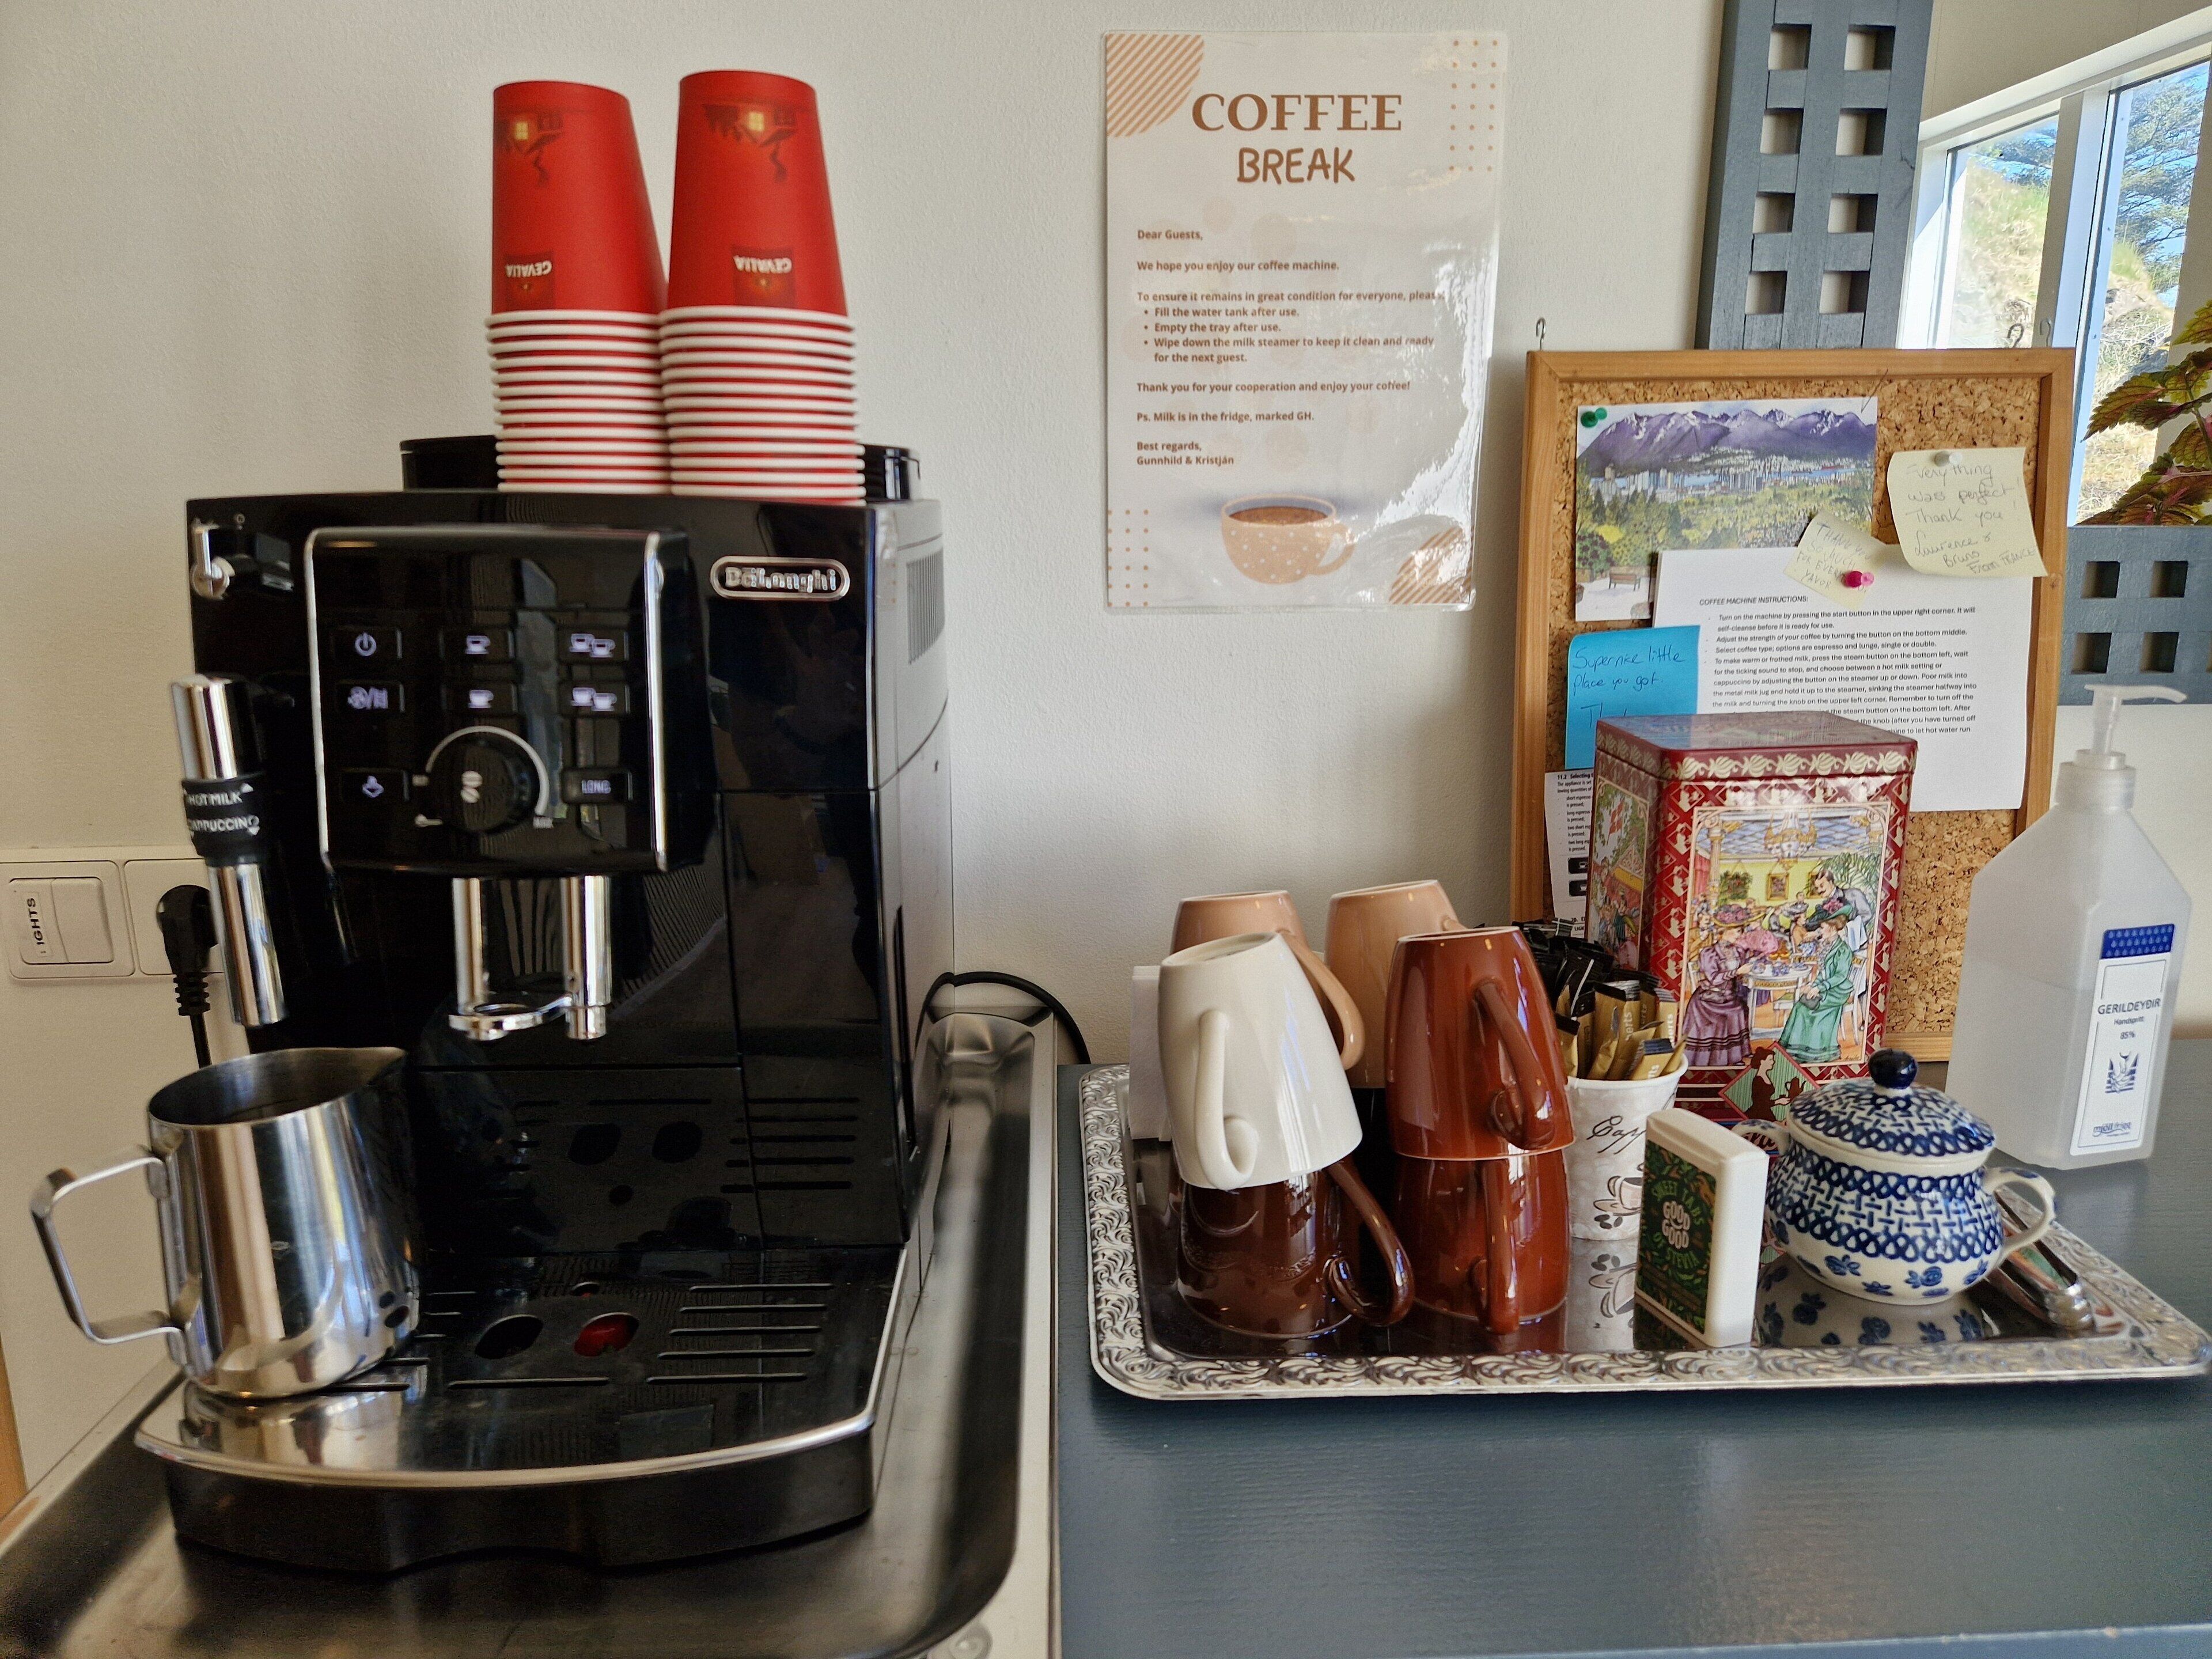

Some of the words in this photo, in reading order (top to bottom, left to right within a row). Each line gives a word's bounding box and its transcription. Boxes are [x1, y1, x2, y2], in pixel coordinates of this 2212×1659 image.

[1192, 93, 1402, 131] COFFEE
[1237, 146, 1355, 184] BREAK
[1137, 229, 1162, 240] Dear
[1164, 229, 1203, 241] Guests,
[1136, 261, 1153, 271] We
[1156, 260, 1182, 273] hope
[1184, 263, 1204, 273] you
[1206, 260, 1235, 274] enjoy
[1237, 262, 1255, 271] our
[1257, 260, 1290, 271] coffee
[1291, 259, 1339, 270] machine.
[1137, 291, 1149, 301] To
[1152, 293, 1188, 302] ensure
[1190, 291, 1198, 302] it
[1200, 291, 1243, 301] remains
[1245, 291, 1255, 301] in
[1256, 292, 1285, 304] great
[1287, 290, 1336, 301] condition
[1338, 290, 1354, 301] for
[1355, 292, 1406, 303] everyone,
[1154, 306, 1169, 317] Fill
[1172, 306, 1190, 317] the
[1191, 308, 1222, 317] water
[1224, 306, 1248, 317] tank
[1251, 306, 1277, 317] after
[1154, 322, 1187, 335] Empty
[1189, 322, 1207, 332] the
[1209, 323, 1230, 334] tray
[1232, 322, 1258, 332] after
[1260, 324, 1281, 332] use.
[1153, 337, 1180, 350] Wipe
[1181, 337, 1210, 347] down
[1213, 337, 1230, 347] the
[1232, 337, 1255, 347] milk
[1257, 338, 1300, 347] steamer
[1302, 338, 1313, 346] to
[1315, 336, 1340, 349] keep
[1343, 336, 1351, 346] it
[1353, 336, 1380, 346] clean
[1382, 335, 1402, 346] and
[1405, 335, 1434, 347] ready
[1153, 352, 1169, 362] for
[1171, 352, 1189, 362] the
[1191, 354, 1214, 362] next
[1216, 354, 1247, 365] guest.
[1136, 382, 1168, 392] Thank
[1170, 384, 1190, 394] you
[1192, 381, 1207, 392] for
[1209, 384, 1233, 394] your
[1234, 381, 1296, 393] cooperation
[1298, 381, 1318, 391] and
[1320, 381, 1349, 393] enjoy
[1350, 382, 1373, 393] your
[1376, 380, 1410, 390] coffee!
[1137, 412, 1150, 422] Ps.
[1153, 412, 1175, 422] Milk
[1177, 412, 1186, 422] is
[1188, 412, 1198, 422] in
[1200, 411, 1218, 422] the
[1219, 411, 1252, 423] fridge,
[1255, 411, 1294, 421] marked
[1296, 411, 1315, 421] GH.
[1137, 441, 1159, 451] Best
[1161, 441, 1202, 453] regards,
[1137, 455, 1182, 465] Gunnhild
[1184, 456, 1192, 465] &
[1195, 455, 1234, 467] Kristján
[1908, 491, 1945, 502] was
[1906, 508, 1962, 524] Thank
[1975, 511, 2002, 527] you
[1758, 595, 1808, 604] INSTRUCTIONS:
[1791, 612, 1820, 620] pressing
[1914, 608, 1930, 616] right
[1791, 622, 1810, 630] ready
[1749, 634, 1776, 642] strength
[1573, 646, 1612, 672] Super
[1649, 645, 1685, 663] little
[1612, 678, 1628, 690] you
[581, 779, 612, 794] LONG
[189, 793, 208, 806] HOT
[210, 791, 243, 806] MILK
[26, 897, 46, 953] IGHTS
[2097, 998, 2161, 1014] GERILDEYÐIR
[2120, 1031, 2135, 1039] 85%
[1662, 1200, 1691, 1230] GOOD
[1662, 1219, 1690, 1249] GOOD
